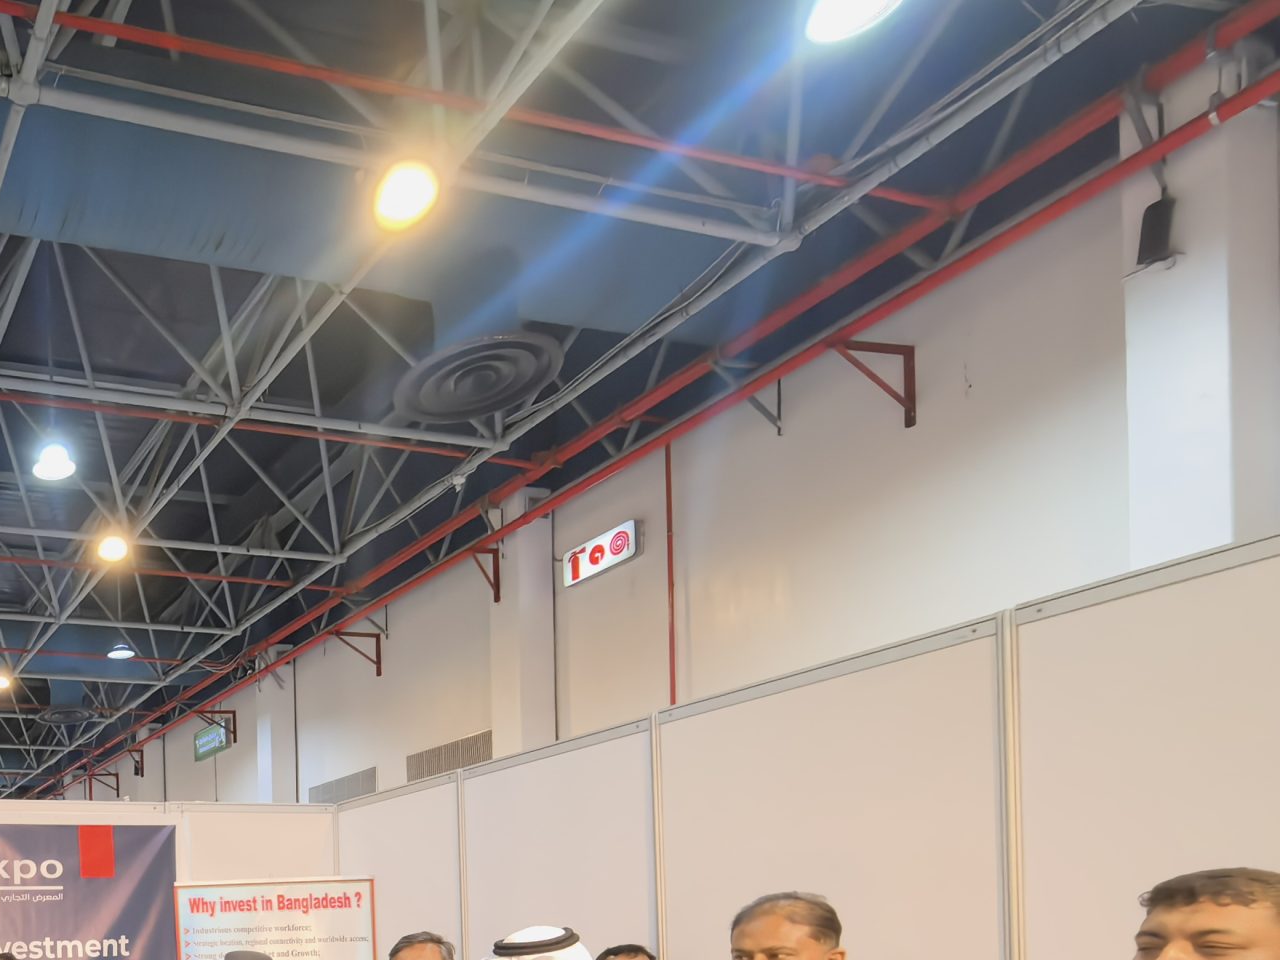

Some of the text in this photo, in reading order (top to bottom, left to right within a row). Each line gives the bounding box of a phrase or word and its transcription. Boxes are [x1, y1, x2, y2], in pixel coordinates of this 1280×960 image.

[0, 893, 30, 903] التجاري
[32, 893, 64, 902] المعرض
[188, 891, 362, 916] Why invest in Bangladesh ?
[233, 925, 273, 935] competitive
[291, 948, 320, 957] Growth;
